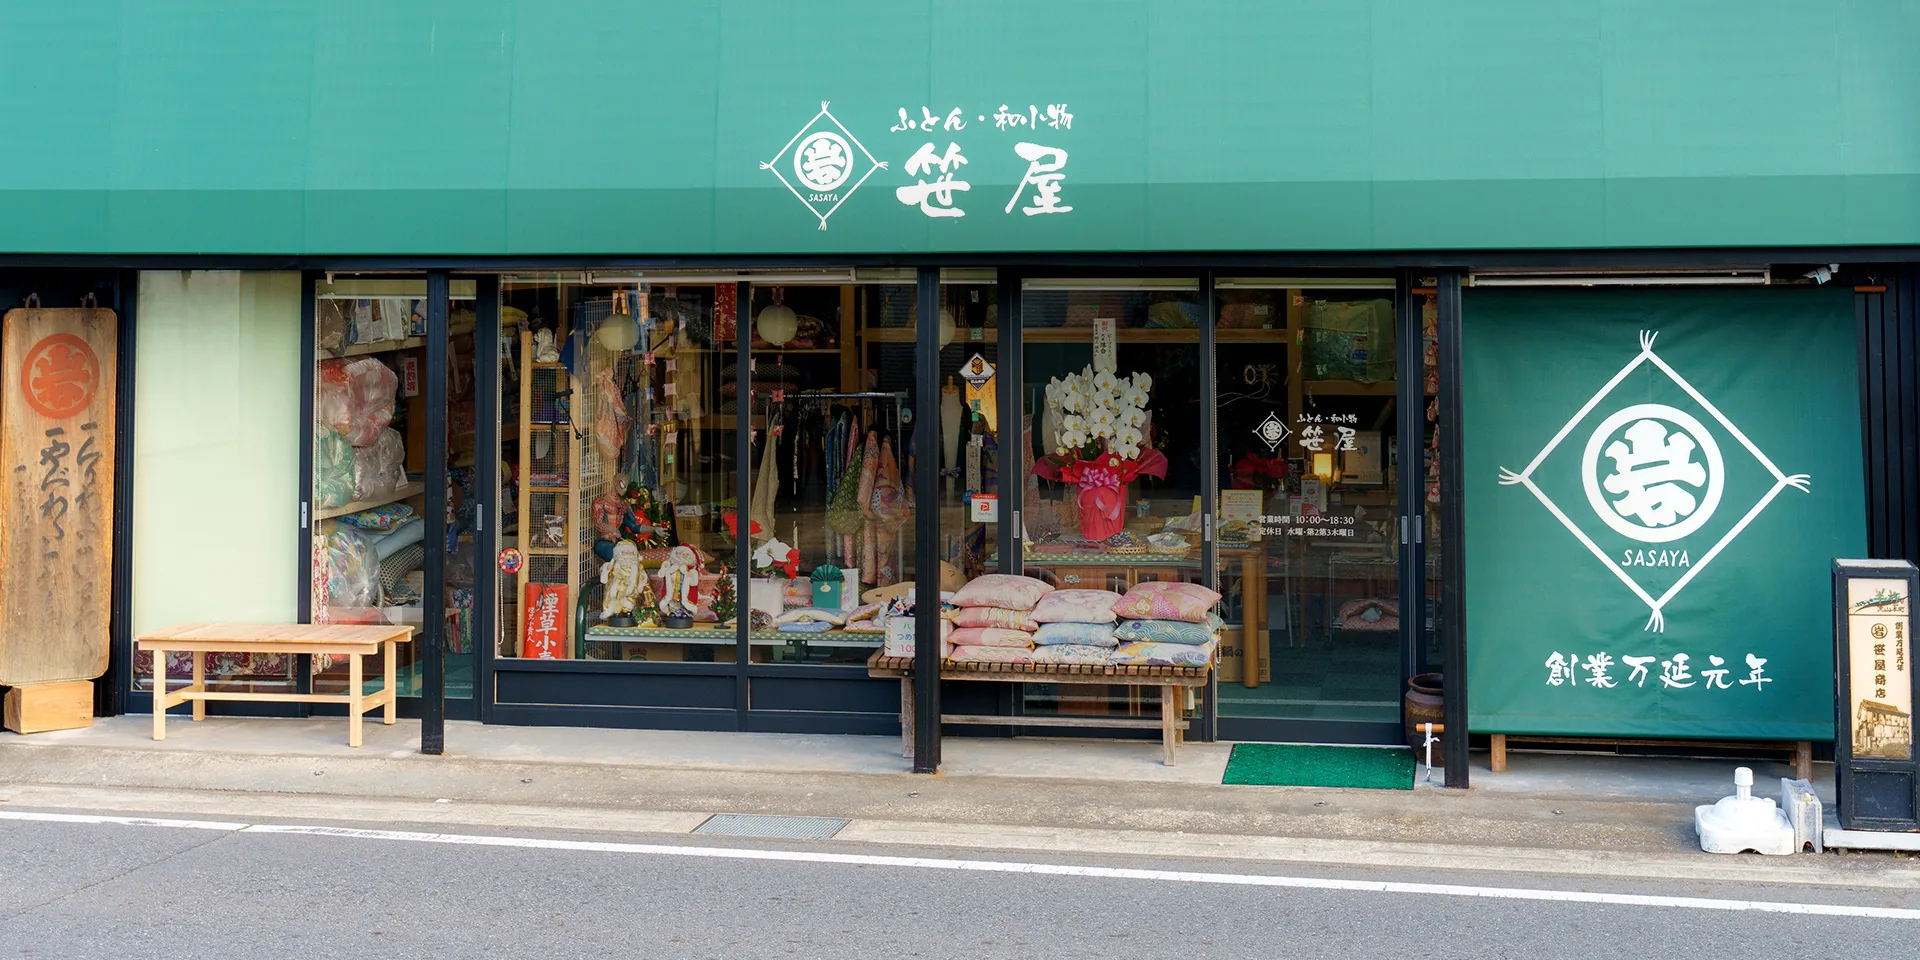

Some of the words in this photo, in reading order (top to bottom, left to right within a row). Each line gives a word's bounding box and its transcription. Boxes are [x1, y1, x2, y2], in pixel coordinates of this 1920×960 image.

[890, 103, 1074, 133] ふとん・和小物
[808, 193, 839, 204] SASAYA
[1259, 515, 1290, 524] 営業時間
[1259, 527, 1282, 536] 定休日
[1621, 549, 1690, 567] SASAYA
[897, 633, 915, 641] つめ
[1545, 650, 1773, 692] 創業万延元年
[1874, 643, 1886, 699] 笹屋商店
